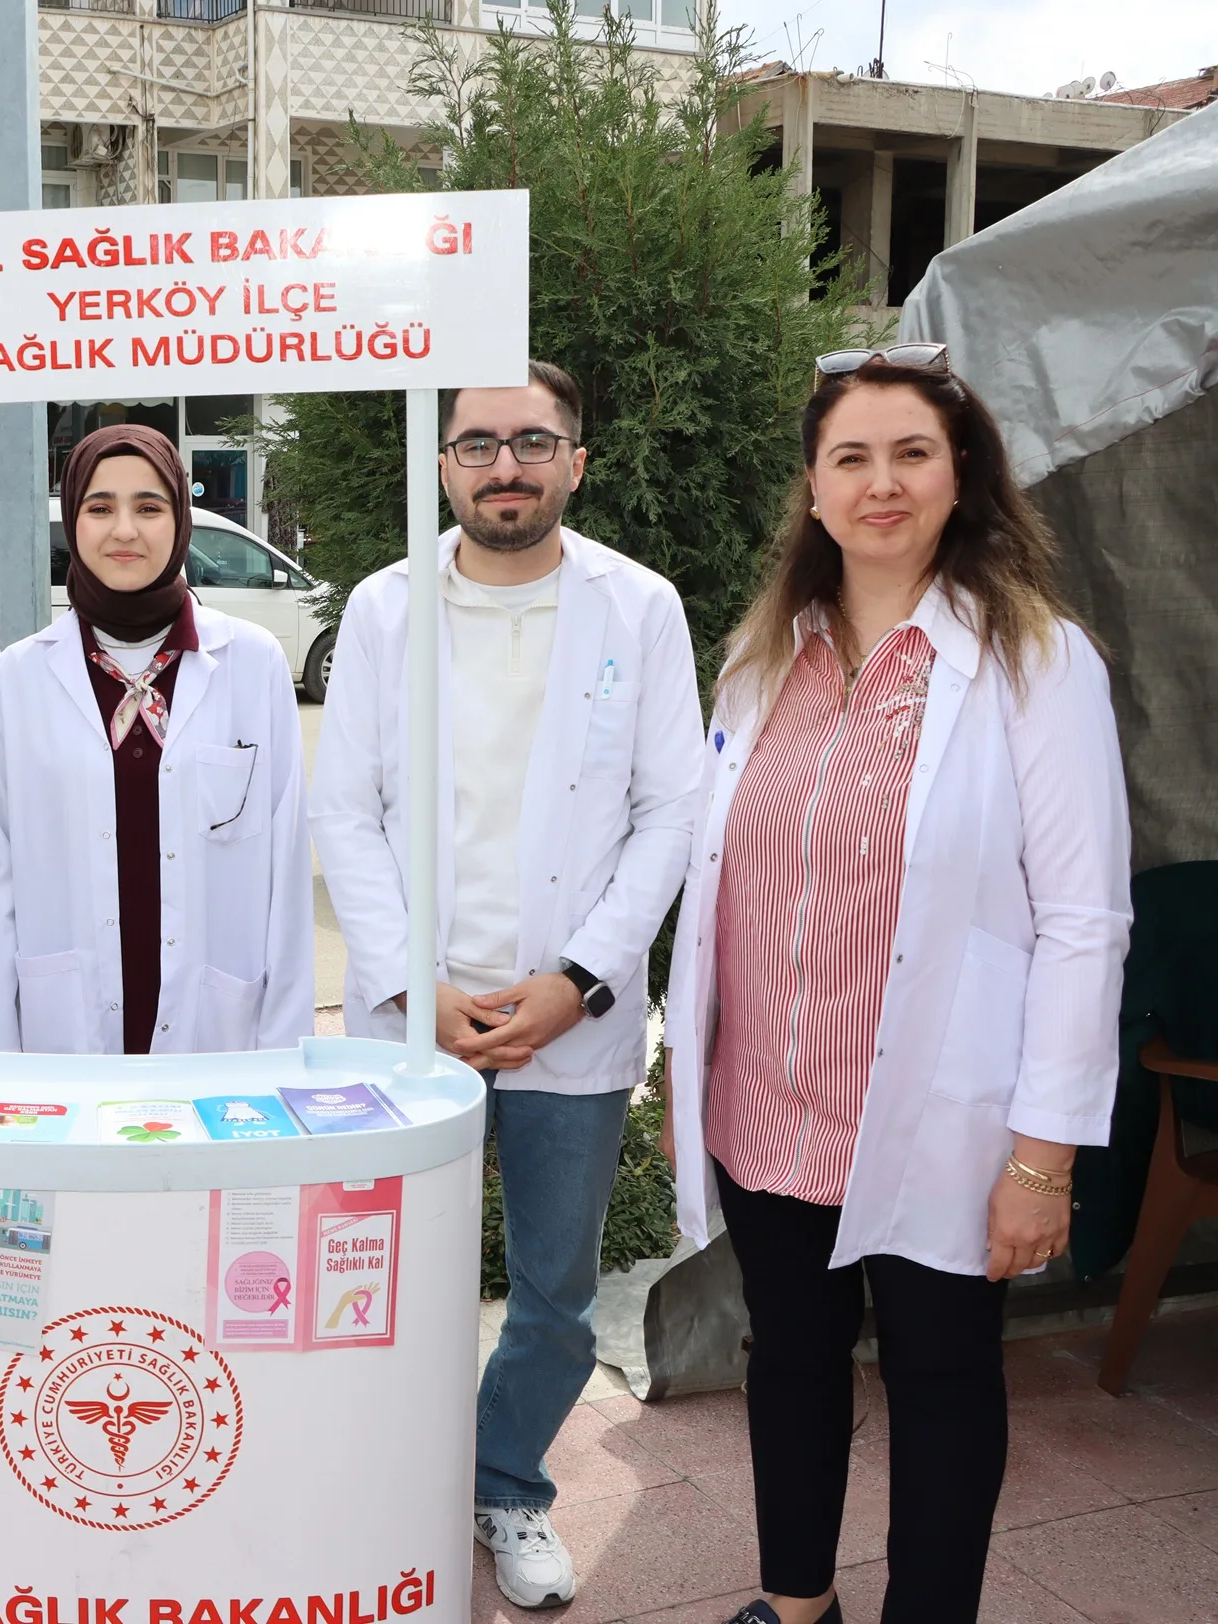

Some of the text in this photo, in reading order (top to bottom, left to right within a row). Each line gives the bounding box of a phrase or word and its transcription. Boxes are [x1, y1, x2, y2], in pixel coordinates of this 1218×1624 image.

[22, 227, 194, 270] SAĞLIK
[210, 214, 472, 264] BAKAĞI
[46, 278, 337, 322] YERKÖY İLÇE
[132, 321, 431, 367] MÜDÜRLÜĞÜ
[326, 1254, 384, 1273] Sağlıklı Kal
[328, 1236, 384, 1256] Geç Kalma
[16, 1282, 40, 1295] İÇİN
[41, 1348, 198, 1480] TÜRKİYE CUMHURİYETİ SAĞLIK BAKANLIĞI
